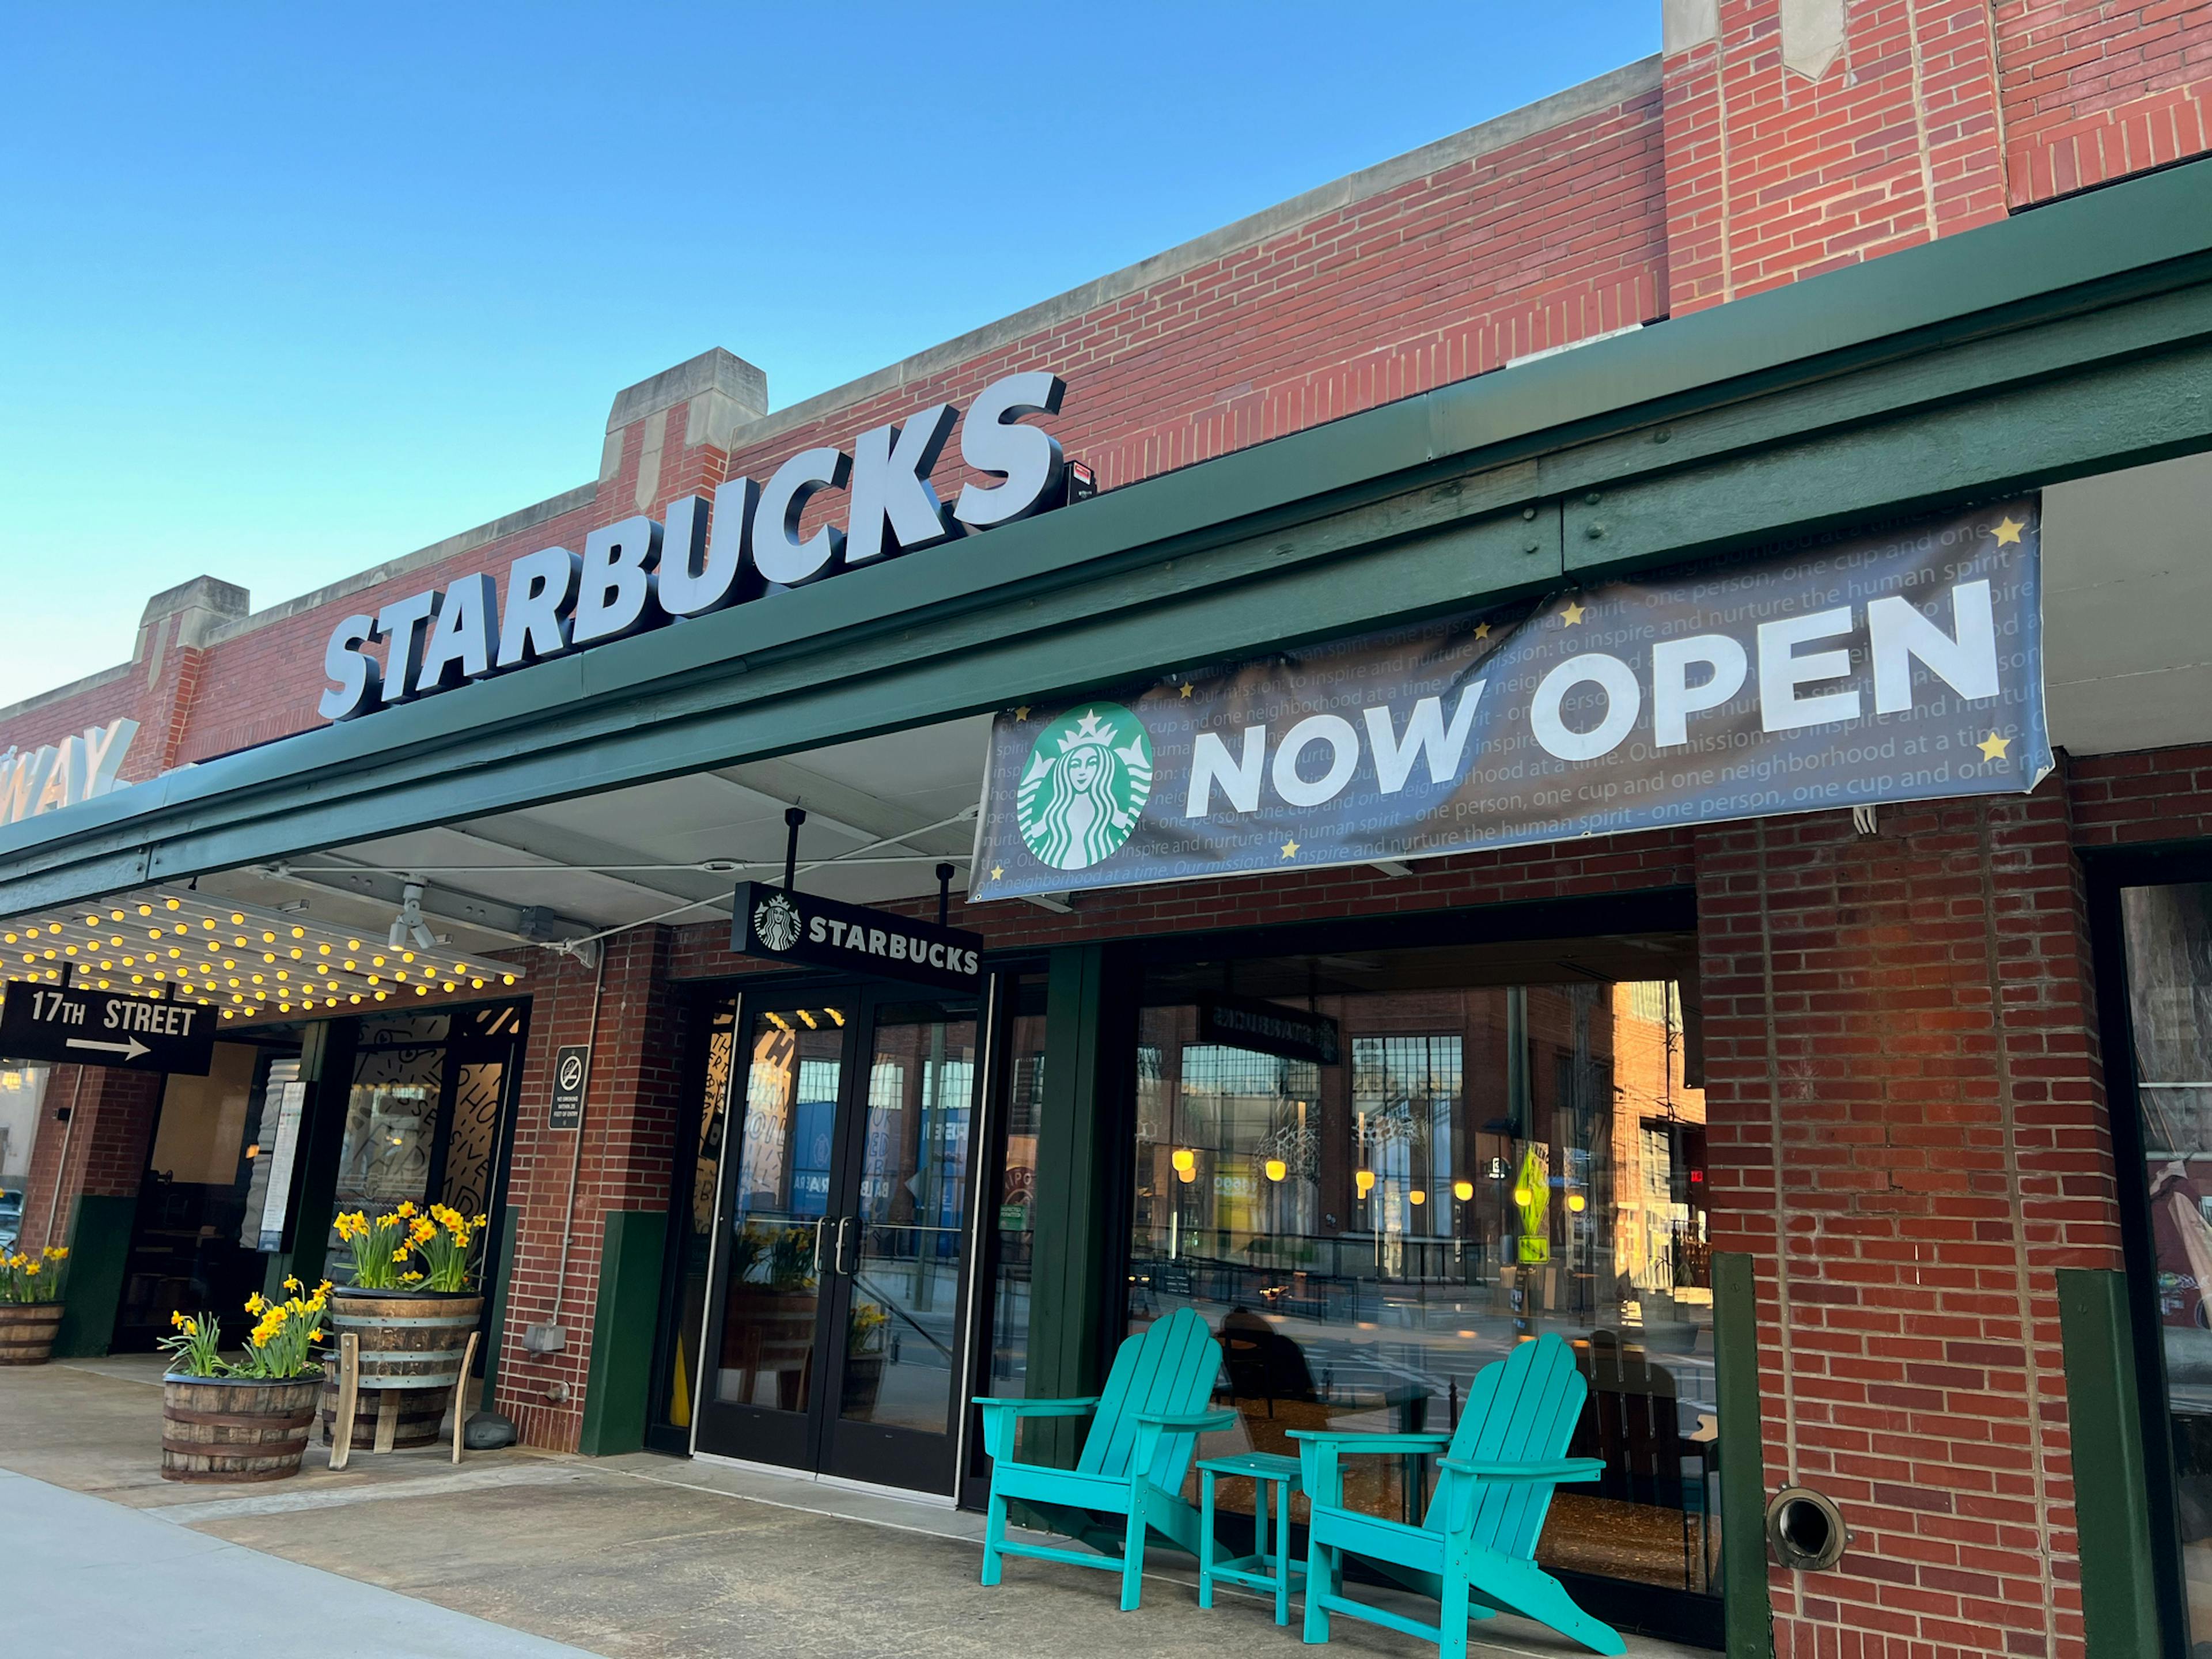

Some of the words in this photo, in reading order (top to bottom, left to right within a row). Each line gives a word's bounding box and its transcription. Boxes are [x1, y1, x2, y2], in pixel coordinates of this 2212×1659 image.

[317, 372, 1066, 721] STARBUCKS
[1645, 588, 1686, 609] one
[1694, 573, 1776, 603] person,
[1783, 559, 1827, 581] one
[1834, 550, 1878, 570] cup
[1885, 529, 1932, 560] and
[1940, 523, 1993, 547] one
[996, 741, 1028, 759] spirit
[1149, 720, 1177, 735] cup
[1181, 712, 1209, 732] and
[1213, 711, 1242, 727] one
[1247, 688, 1363, 722] neighborhood
[1366, 689, 1382, 702] at
[1387, 688, 1397, 700] a
[1402, 676, 1445, 696] time.
[1558, 638, 1579, 654] to
[1584, 623, 1655, 649] inspire
[1661, 608, 1702, 634] and
[1709, 596, 1794, 627] nurture
[1801, 586, 1841, 608] the
[1847, 567, 1936, 599] human
[1944, 549, 2010, 581] spirit
[1185, 679, 1487, 818] NOW
[1530, 579, 1999, 761] OPEN
[1290, 672, 1306, 689] to
[1312, 662, 1365, 687] inspire
[1371, 654, 1402, 676] and
[1409, 643, 1472, 669] nurture
[1122, 841, 1169, 861] inspire
[1172, 837, 1199, 854] and
[1204, 832, 1264, 850] nurture
[1267, 828, 1294, 843] the
[1298, 821, 1355, 840] human
[1359, 809, 1401, 831] spirit
[1414, 805, 1449, 821] one
[1455, 793, 1528, 822] person,
[1533, 787, 1573, 806] one
[1578, 783, 1619, 802] cup
[1623, 770, 1664, 796] and
[1671, 769, 1715, 789] one
[1721, 737, 1896, 782] neighborhood
[1903, 735, 1928, 756] at
[1936, 734, 1950, 751] a
[1529, 759, 1550, 777] at
[1555, 760, 1566, 774] a
[1005, 870, 1103, 892] neighborhood
[1105, 870, 1117, 883] at
[1121, 869, 1130, 880] a
[1134, 863, 1169, 878] time.
[1175, 860, 1205, 875] Our
[1209, 854, 1269, 872] mission:
[1294, 844, 1349, 864] inspire
[1353, 836, 1385, 857] and
[1390, 830, 1459, 854] nurture
[1464, 824, 1496, 842] the
[1501, 820, 1573, 839] human
[1578, 806, 1632, 830] spirit
[1651, 801, 1694, 820] one
[1700, 789, 1786, 818] person,
[1793, 781, 1840, 801] one
[1846, 775, 1893, 795] cup
[1900, 760, 1950, 787] and
[1958, 759, 2011, 780] one
[809, 915, 979, 975] STARBUCKS
[32, 990, 86, 1025] 17TH
[104, 999, 196, 1036] STREET
